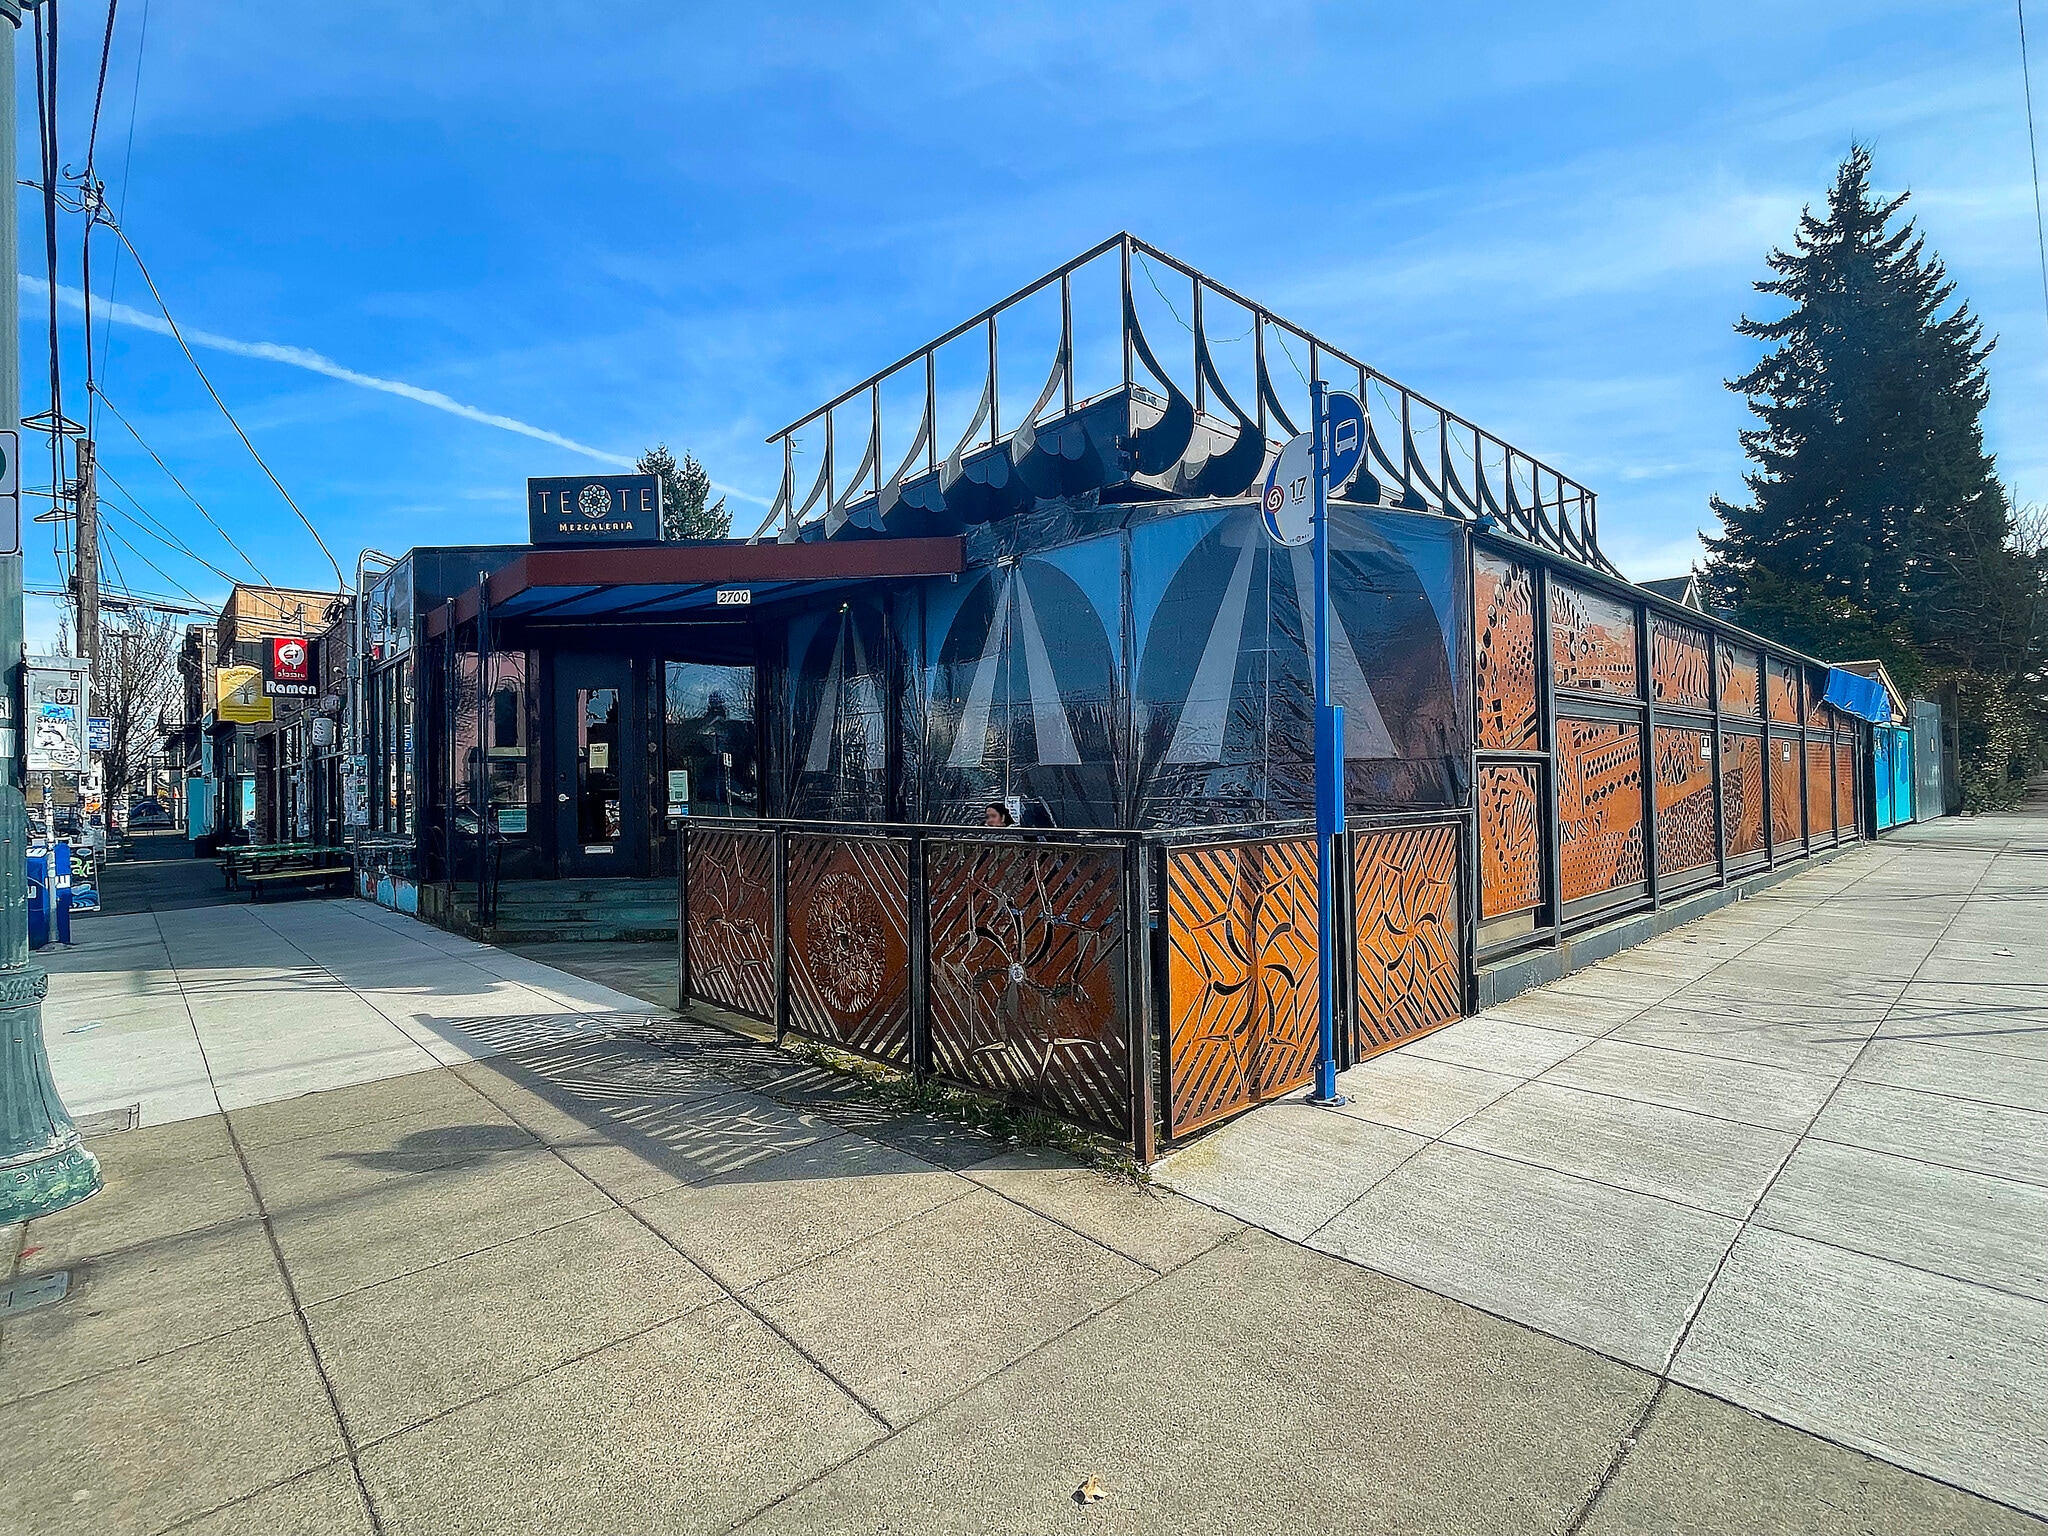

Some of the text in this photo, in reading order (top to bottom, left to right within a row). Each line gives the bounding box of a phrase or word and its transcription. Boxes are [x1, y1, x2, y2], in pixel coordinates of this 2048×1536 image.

[1289, 475, 1308, 500] 17
[537, 484, 653, 519] TEOTE
[559, 521, 634, 532] MEZCALERIA
[718, 591, 749, 603] 2700
[265, 680, 317, 695] Ramen
